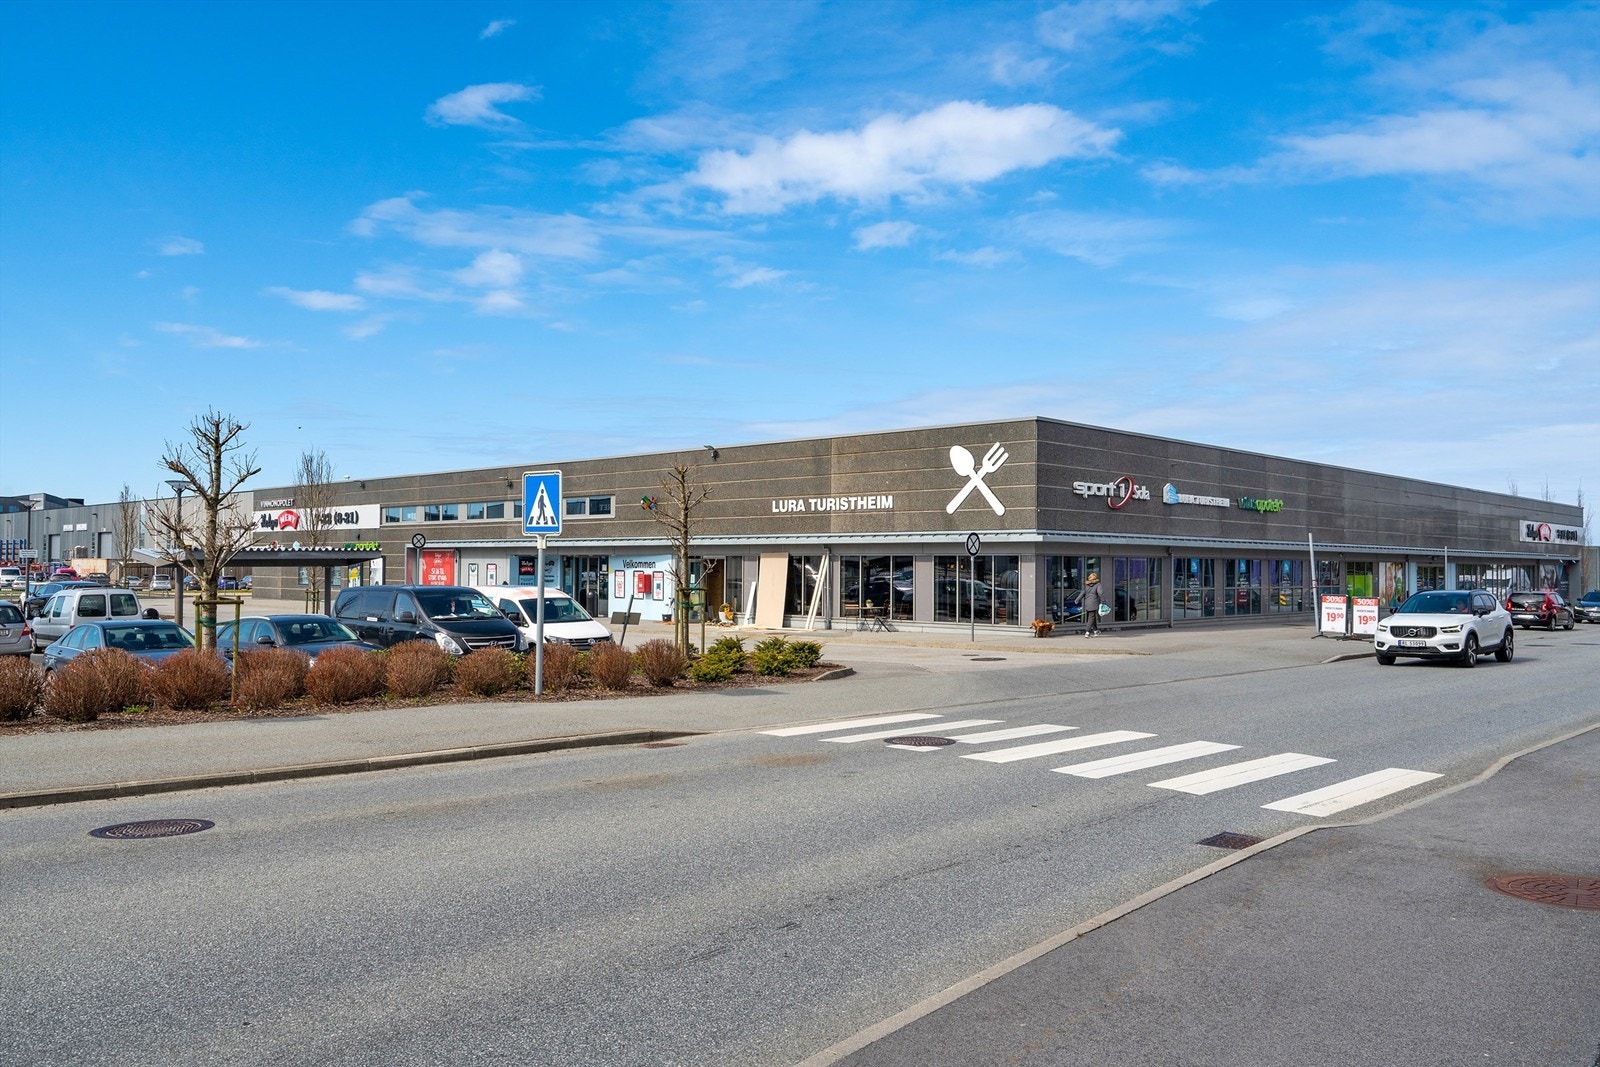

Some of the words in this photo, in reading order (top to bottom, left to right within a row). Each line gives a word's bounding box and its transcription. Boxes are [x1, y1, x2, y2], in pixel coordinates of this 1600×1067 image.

[1073, 481, 1117, 499] sport
[260, 498, 294, 508] VINMONOPOLET
[772, 499, 806, 513] LURA
[809, 495, 894, 512] TURISTHEIM
[622, 559, 656, 569] Velkommen
